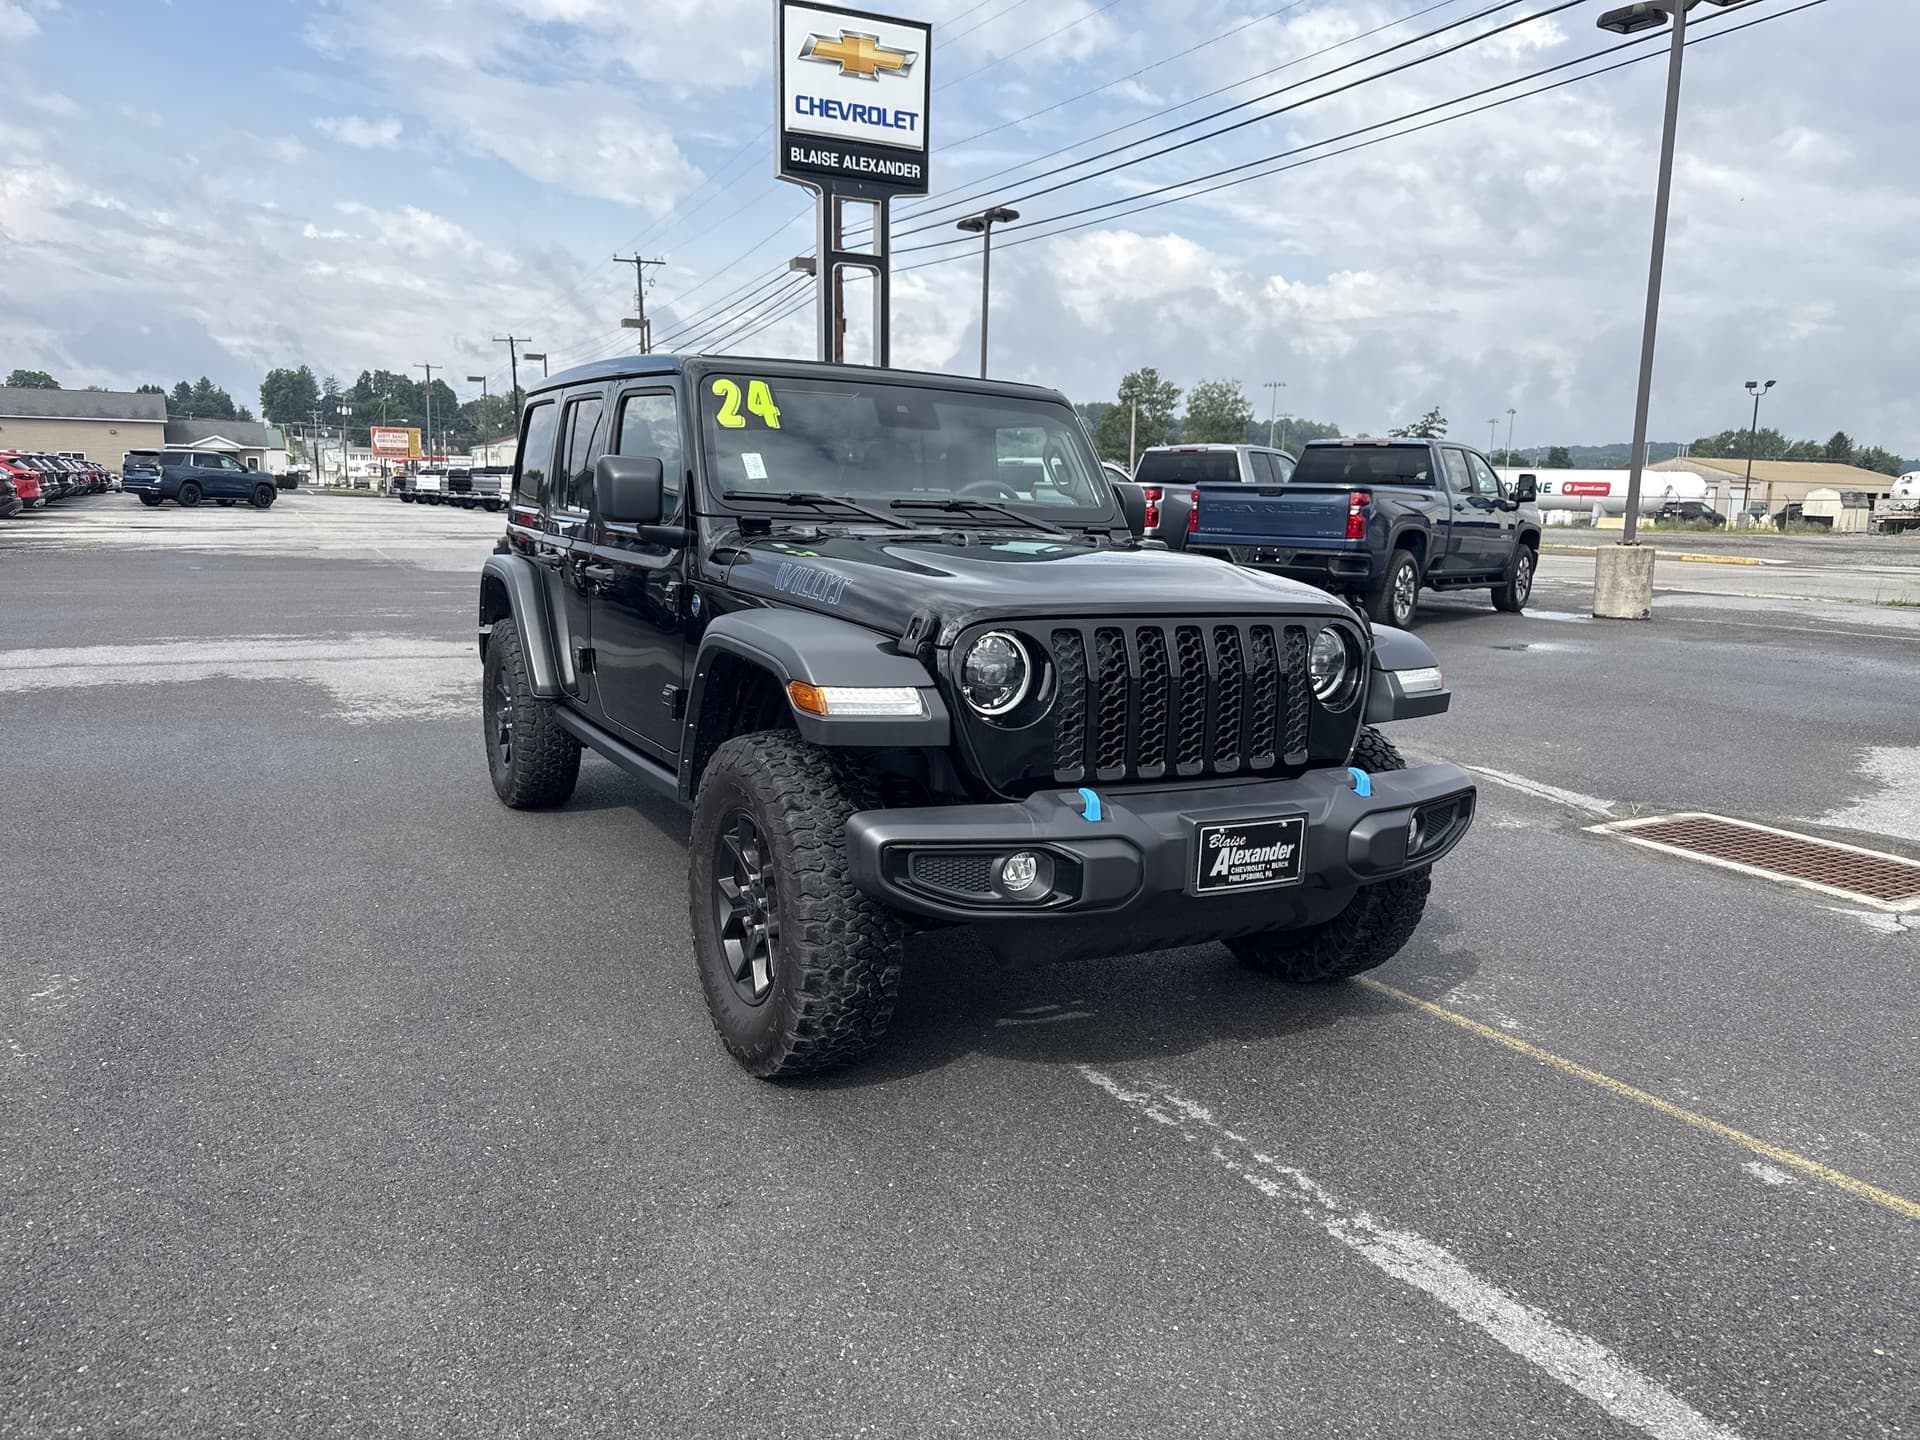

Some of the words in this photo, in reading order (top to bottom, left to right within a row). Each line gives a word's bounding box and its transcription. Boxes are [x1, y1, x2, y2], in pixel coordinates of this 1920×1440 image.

[795, 94, 919, 131] CHEVROLET
[790, 147, 839, 167] BLAISE
[843, 155, 921, 179] ALEXANDER
[712, 378, 780, 429] 24
[1209, 833, 1247, 848] Blaise
[1209, 841, 1295, 877] Alexander
[1230, 863, 1266, 874] CHEVROLET
[1271, 860, 1289, 869] BUICK
